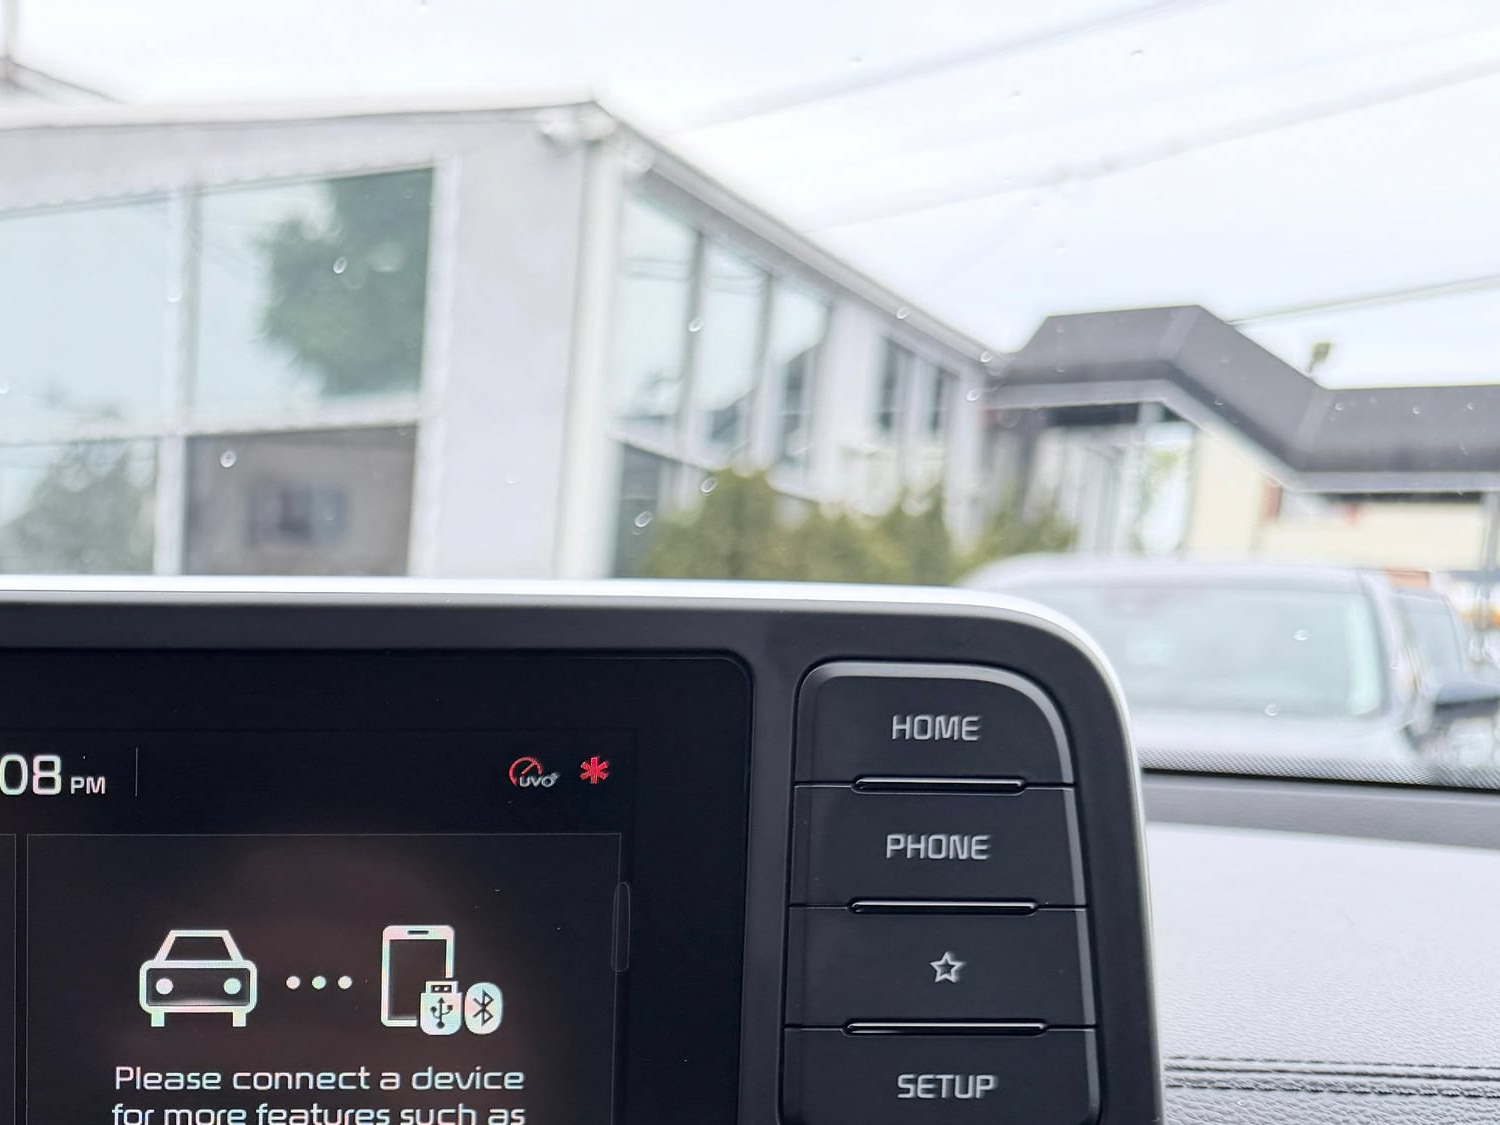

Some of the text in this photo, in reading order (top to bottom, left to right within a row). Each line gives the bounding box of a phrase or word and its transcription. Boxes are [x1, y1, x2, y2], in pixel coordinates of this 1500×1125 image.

[891, 714, 980, 741] HOME
[70, 776, 106, 795] PM
[886, 833, 990, 860] PHONE
[115, 1065, 525, 1091] Please connect a device
[897, 1073, 996, 1099] SETUP
